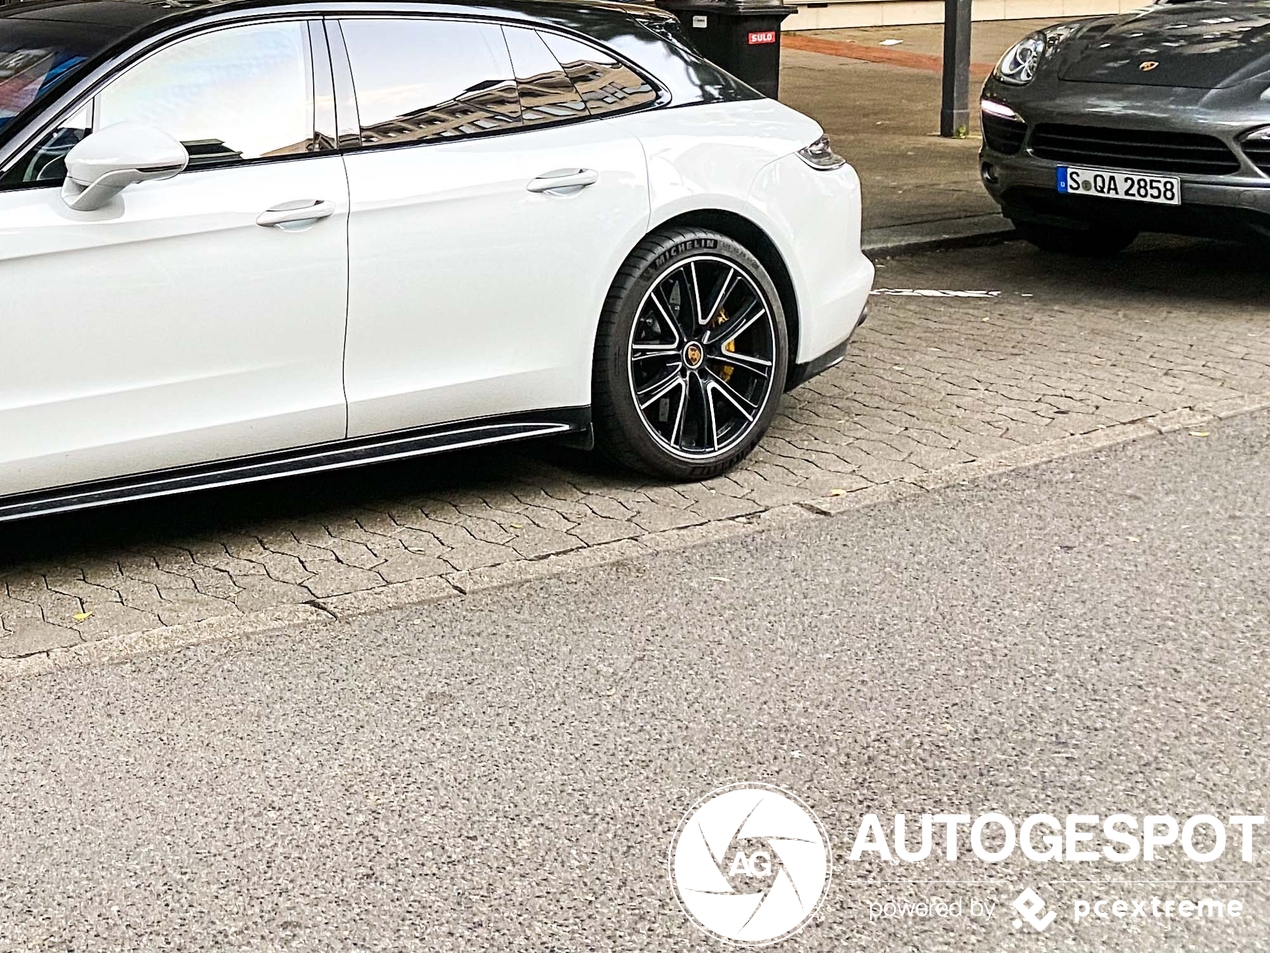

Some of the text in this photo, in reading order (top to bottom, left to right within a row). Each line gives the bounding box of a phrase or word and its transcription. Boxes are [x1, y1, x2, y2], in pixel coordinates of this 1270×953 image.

[751, 33, 773, 43] SULO
[1069, 171, 1175, 201] S QA 2858
[655, 238, 715, 266] MICHELIN
